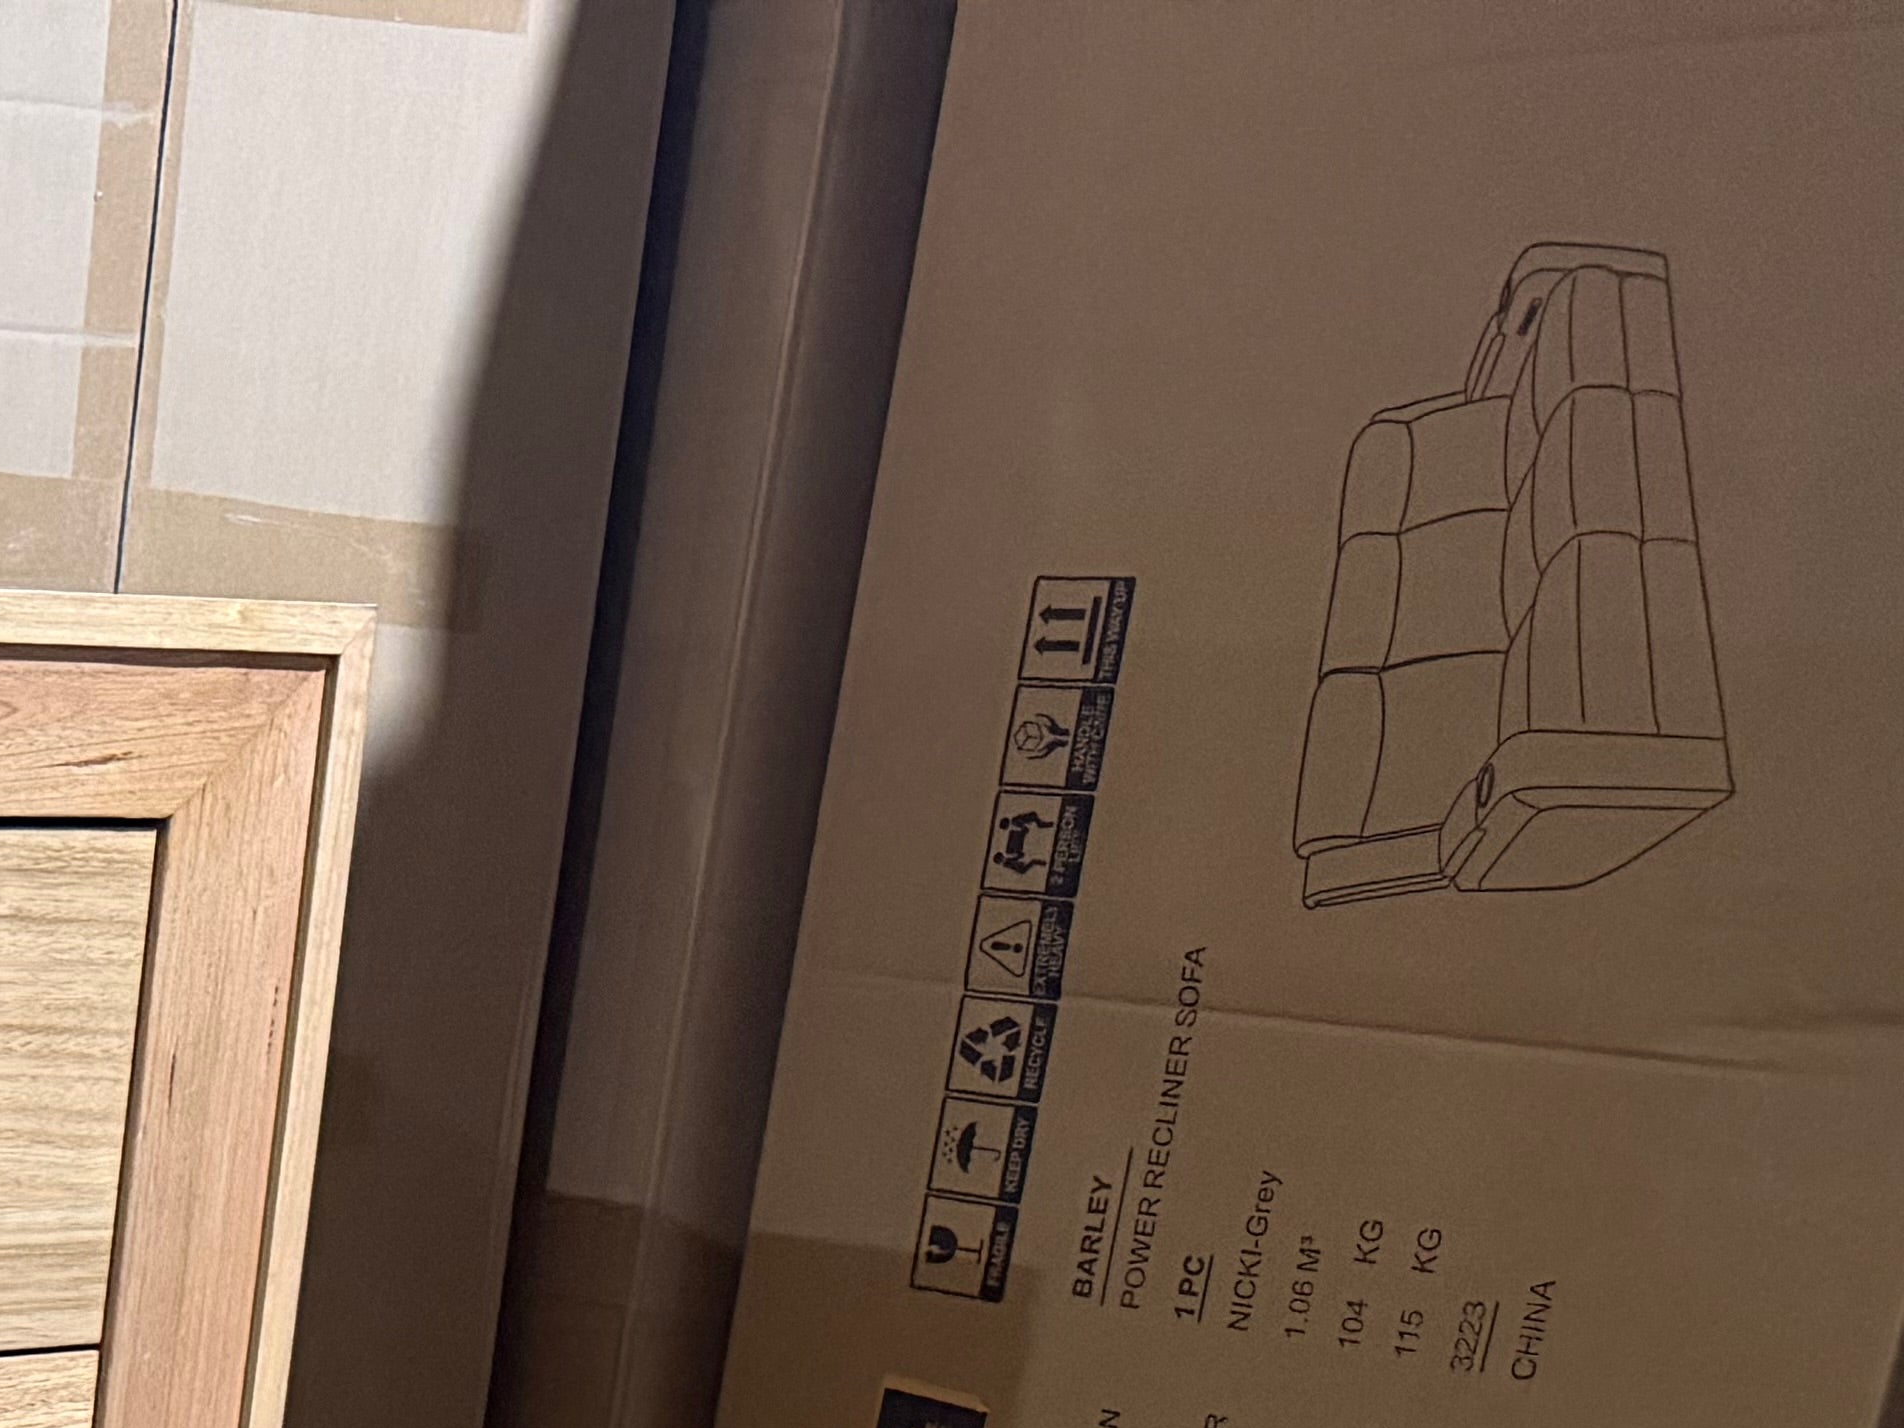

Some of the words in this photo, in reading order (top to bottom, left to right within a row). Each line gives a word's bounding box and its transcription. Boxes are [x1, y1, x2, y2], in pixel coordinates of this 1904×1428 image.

[1104, 606, 1125, 643] WAY
[1099, 643, 1119, 679] THIS
[1071, 704, 1093, 772] HANDLE
[1054, 805, 1078, 873] PERSON
[1023, 1016, 1048, 1090] RECYCLE
[1011, 1116, 1031, 1151] DRY
[1120, 1195, 1161, 1311] POWER
[1143, 1035, 1193, 1191] RECLINER
[1175, 945, 1207, 1028] SOFA
[1004, 1150, 1022, 1194] KEEP
[1072, 1174, 1113, 1298] BARLEY
[1227, 1169, 1284, 1332] NICKI-Grey
[1178, 1254, 1206, 1298] PC
[1284, 1280, 1314, 1338] 1.06
[1337, 1299, 1368, 1348] 104
[1353, 1219, 1384, 1265] KG
[1394, 1309, 1424, 1358] 115
[1410, 1227, 1443, 1274] KG
[1173, 1303, 1195, 1321] 1
[1449, 1300, 1487, 1373] 3223
[1511, 1280, 1557, 1381] CHINA
